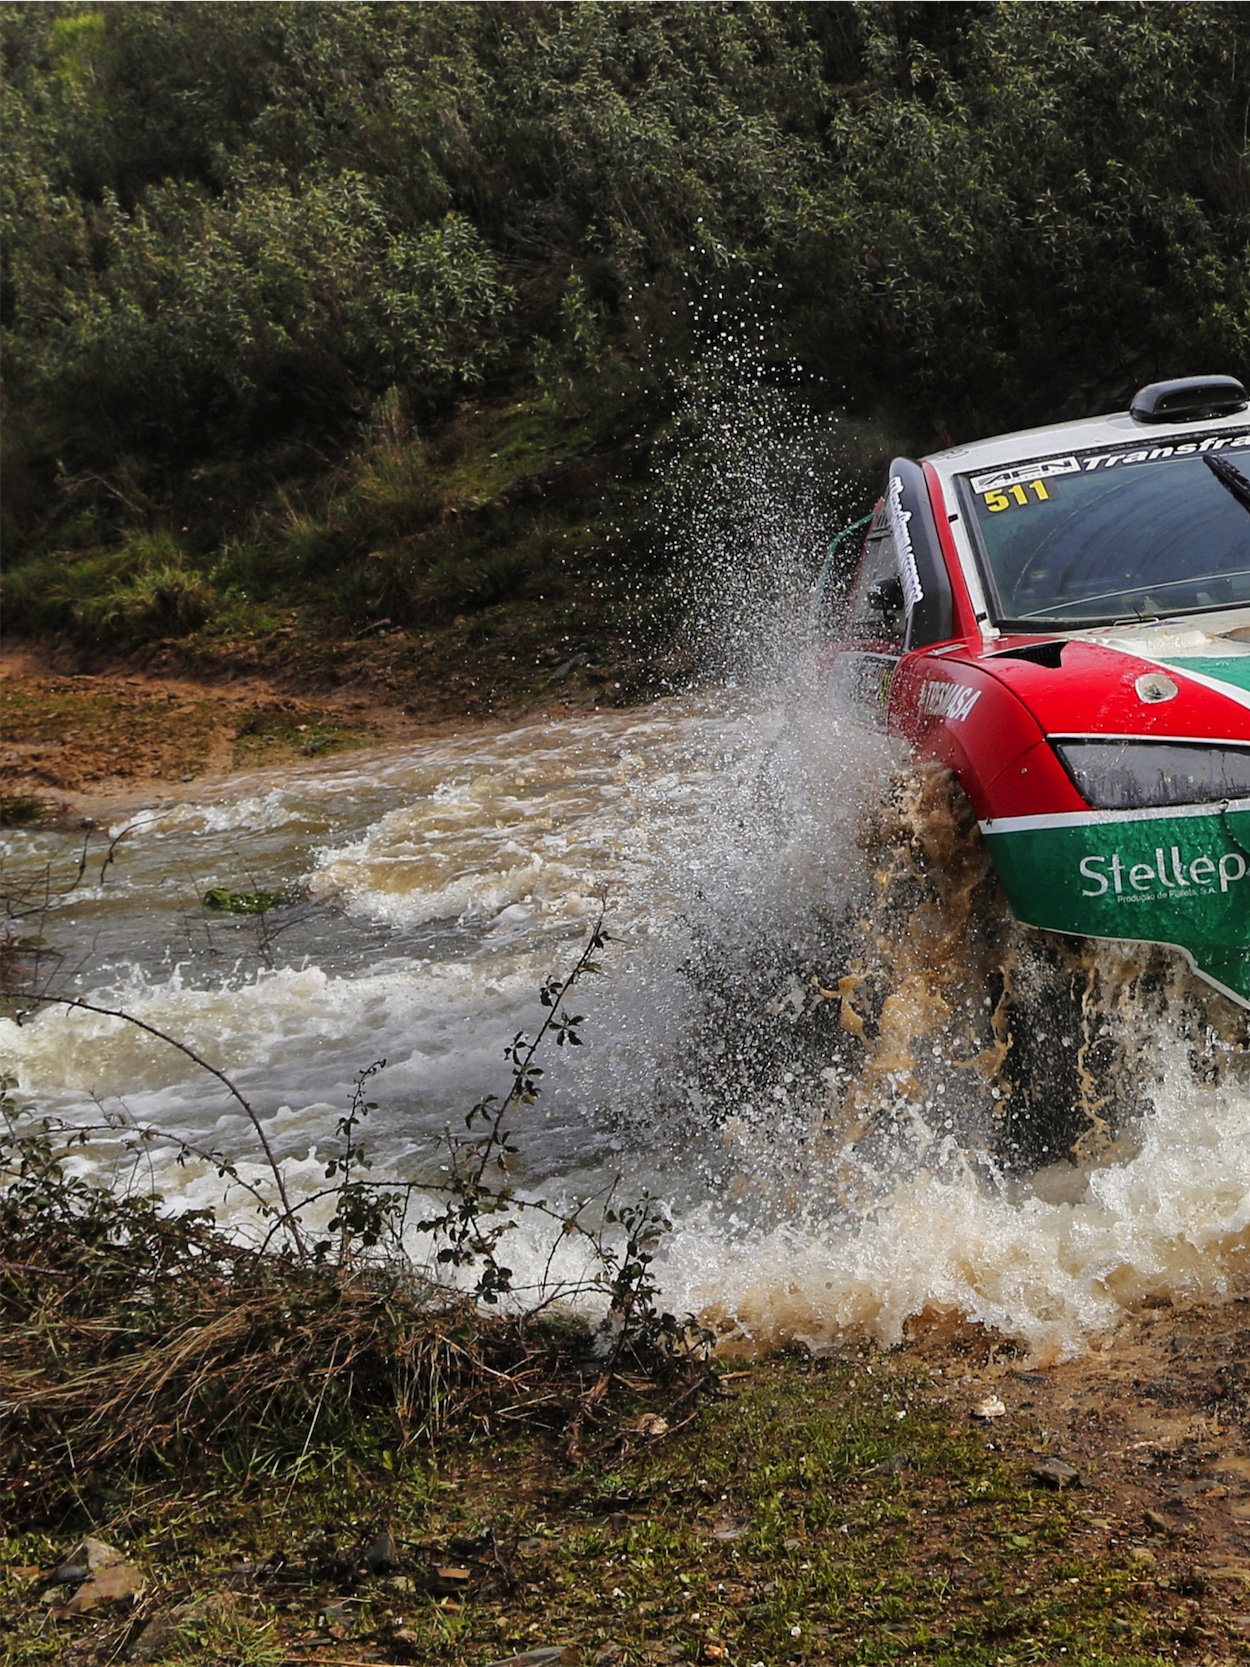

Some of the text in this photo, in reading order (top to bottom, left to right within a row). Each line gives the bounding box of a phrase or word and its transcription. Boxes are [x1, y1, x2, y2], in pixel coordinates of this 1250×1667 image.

[984, 480, 1049, 512] 511
[1079, 846, 1247, 897] Stellep
[1157, 891, 1168, 899] de
